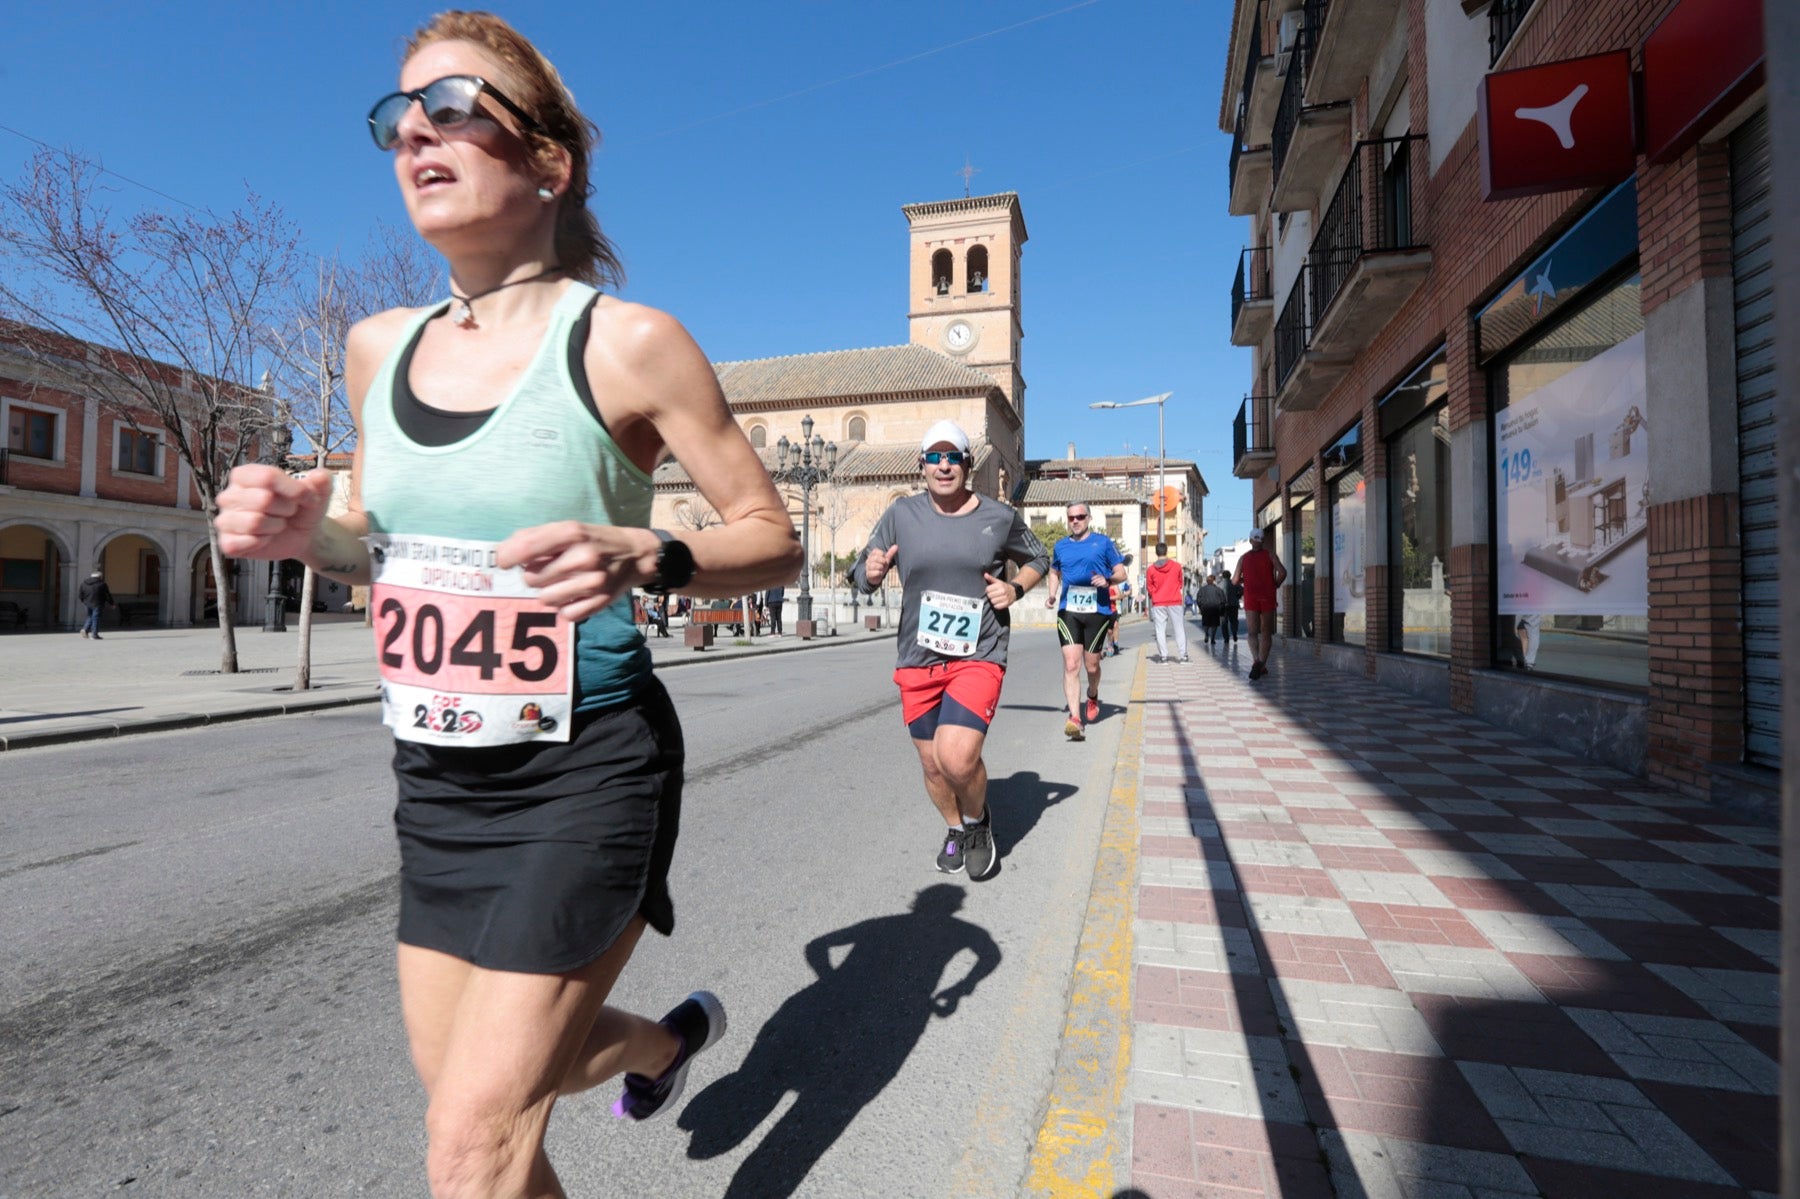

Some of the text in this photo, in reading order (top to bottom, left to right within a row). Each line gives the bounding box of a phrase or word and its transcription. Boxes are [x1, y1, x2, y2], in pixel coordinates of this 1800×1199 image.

[1501, 448, 1531, 487] 149
[1072, 593, 1093, 605] 174
[928, 611, 970, 636] 272
[380, 598, 558, 682] 2045
